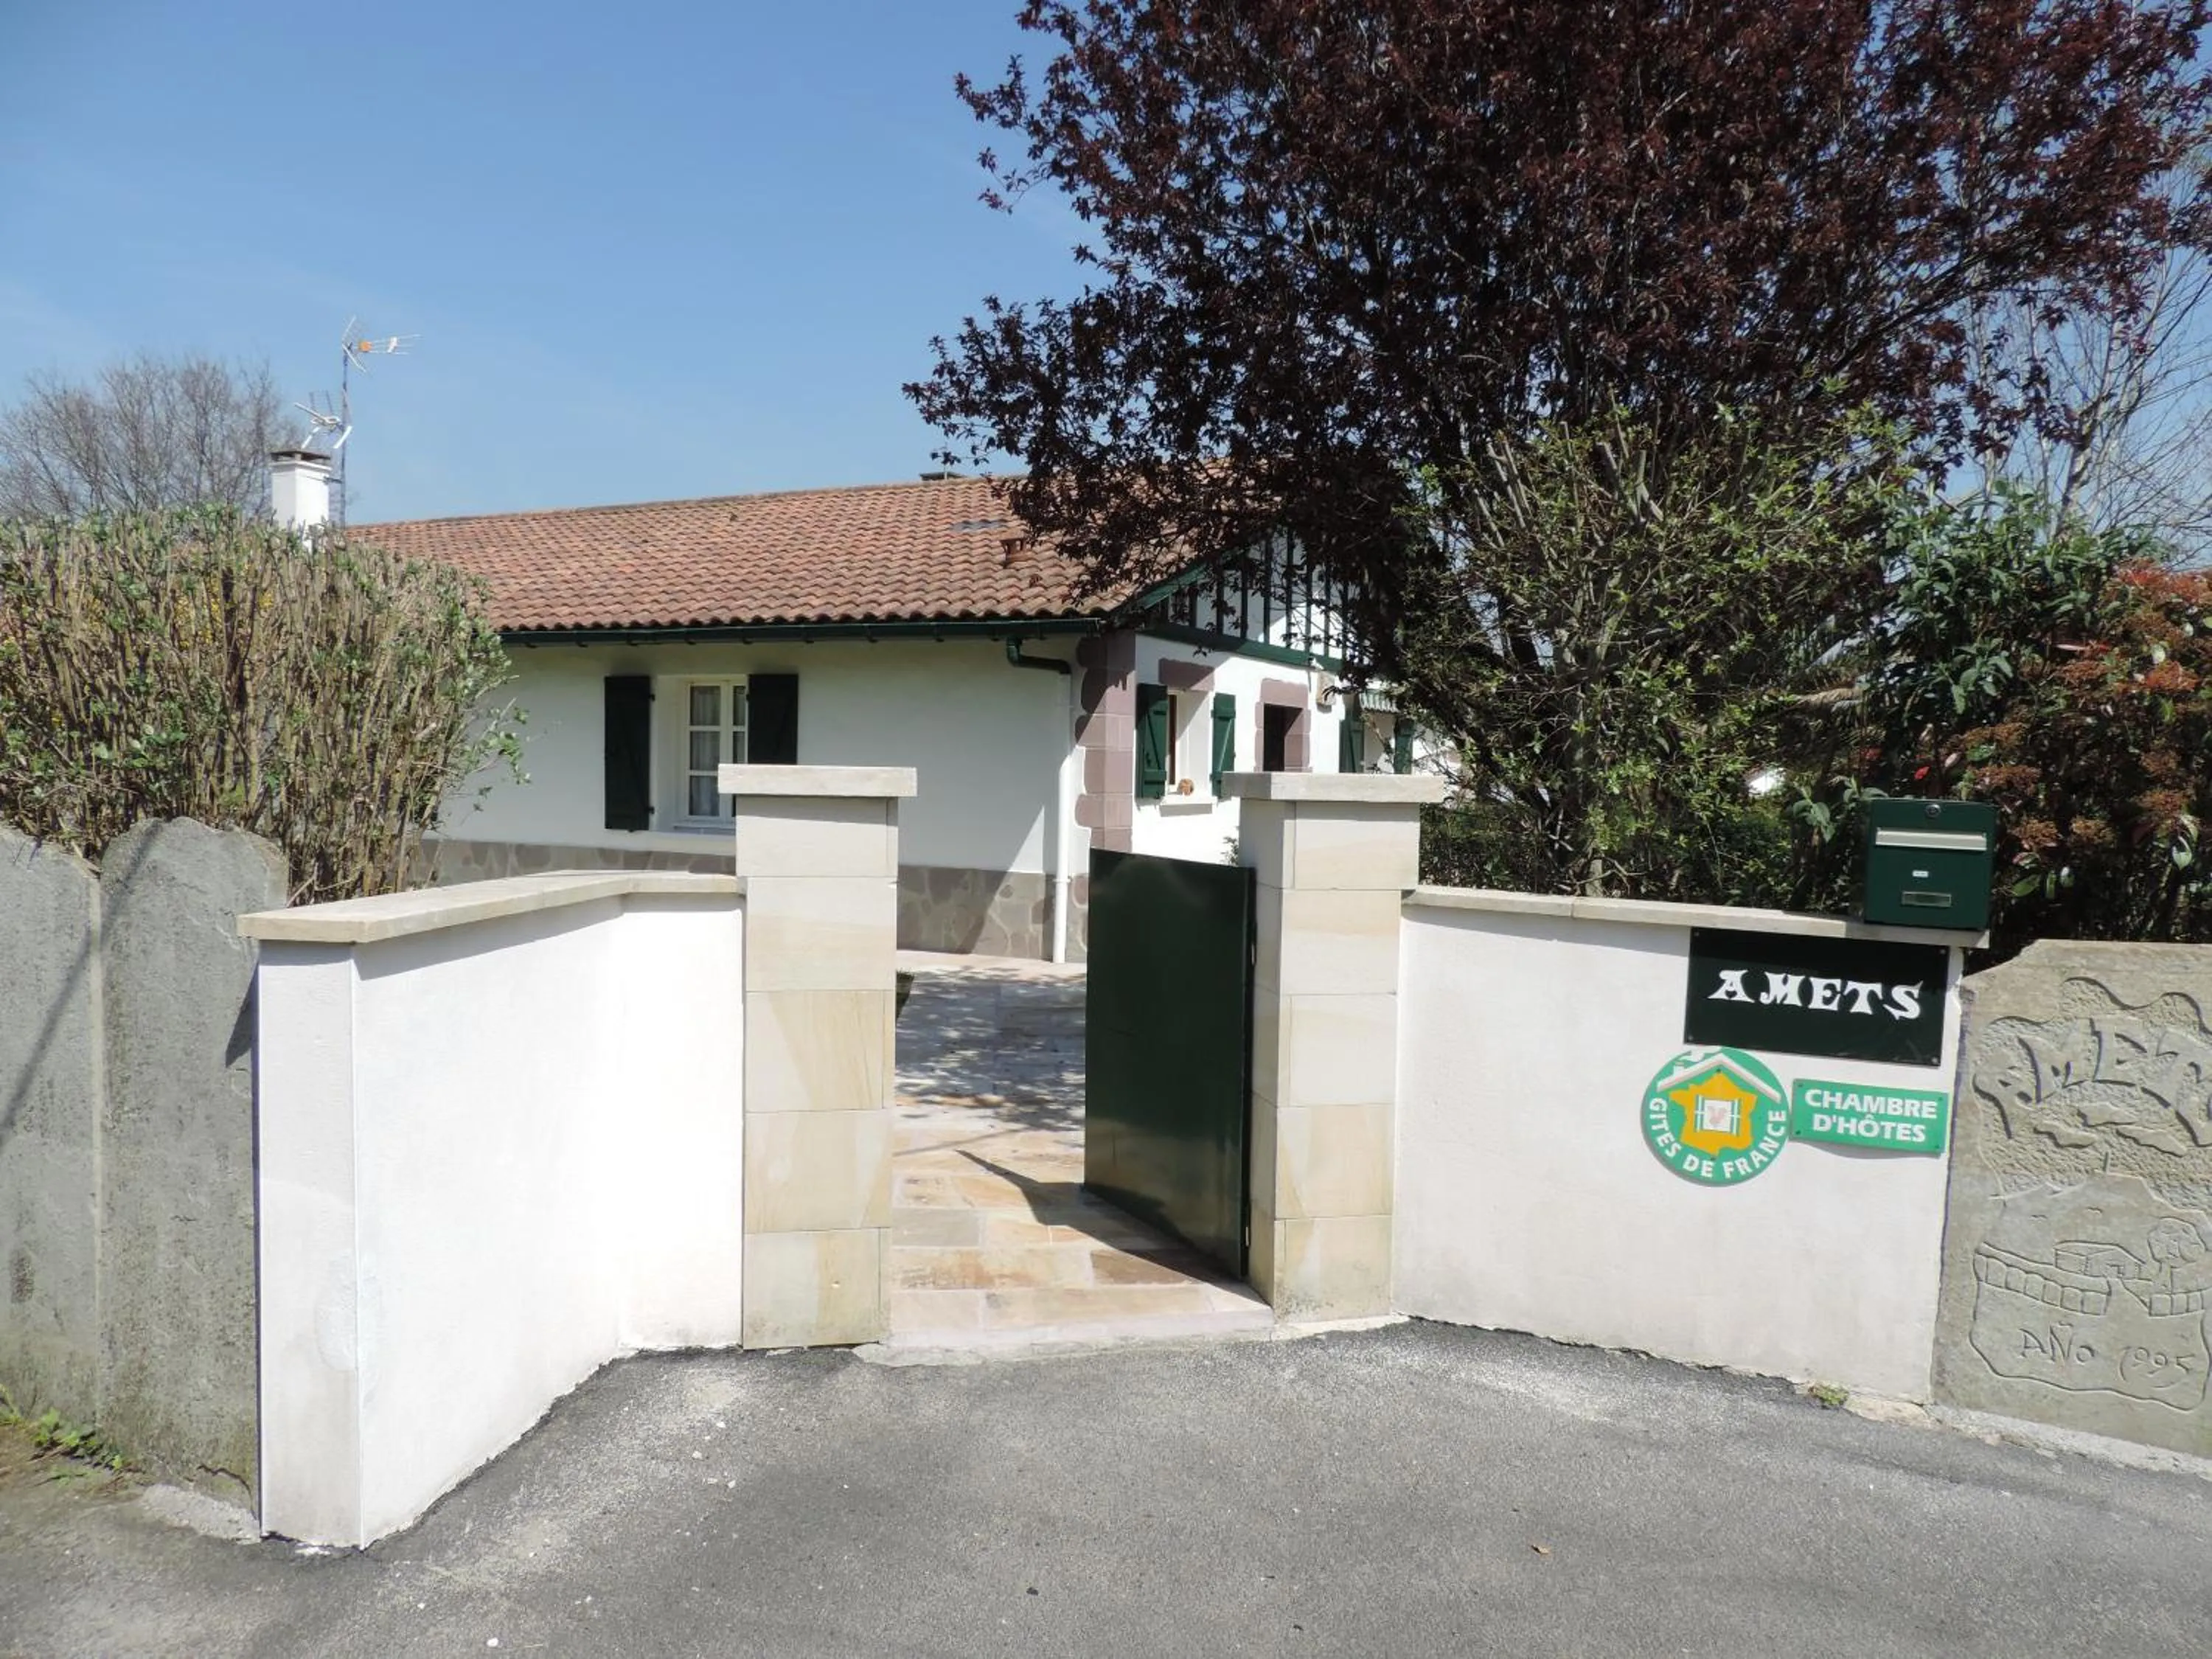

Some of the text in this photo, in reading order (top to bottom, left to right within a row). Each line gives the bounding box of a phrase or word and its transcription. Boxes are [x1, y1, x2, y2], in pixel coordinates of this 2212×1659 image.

[1707, 969, 1924, 1020] AMETS
[1805, 1088, 1938, 1119] CHAMBRE
[1649, 1097, 1787, 1180] GITES DE FRANCE
[1812, 1113, 1927, 1142] D'HÔTES
